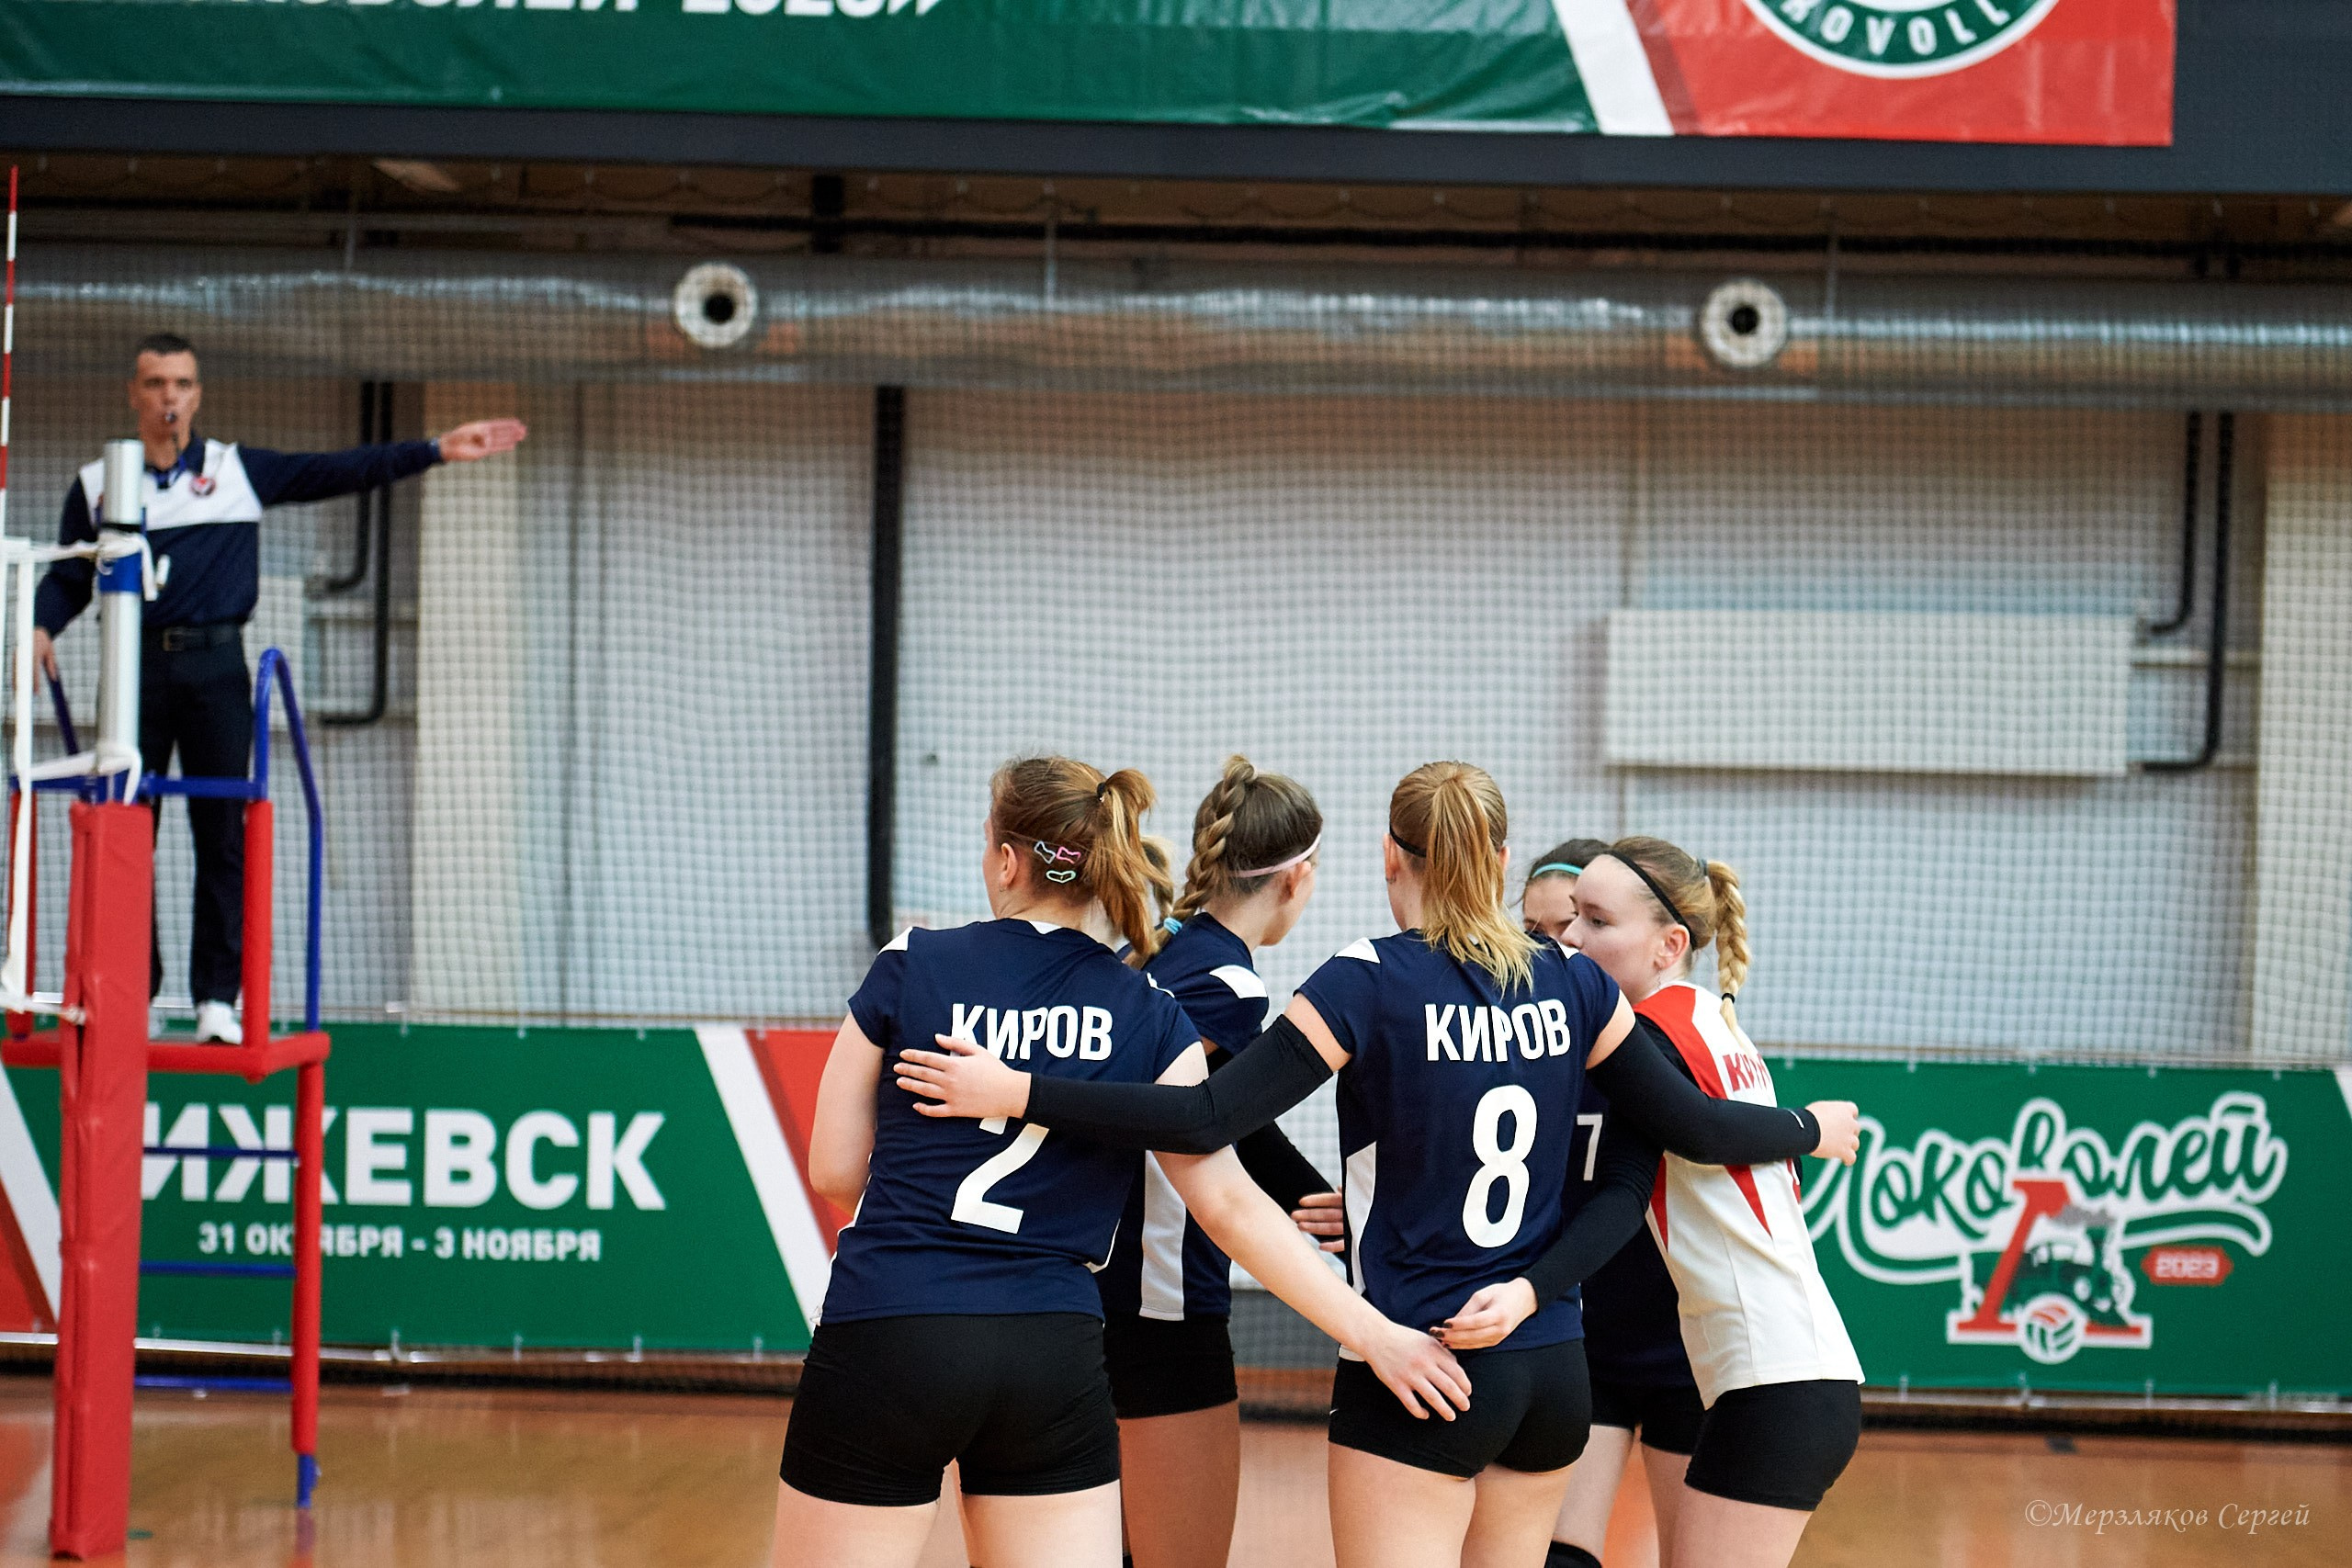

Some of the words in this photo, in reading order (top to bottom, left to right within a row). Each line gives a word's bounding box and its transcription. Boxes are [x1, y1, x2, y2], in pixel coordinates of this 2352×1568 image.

[950, 1003, 1114, 1061] КИРОВ
[1425, 998, 1571, 1063] КИРОВ
[141, 1101, 666, 1211] ИЖЕВСК
[950, 1117, 1049, 1235] 2
[1462, 1084, 1538, 1249] 8
[1577, 1113, 1603, 1181] 7
[198, 1221, 235, 1255] 31
[244, 1222, 402, 1258] ОКЯБРЯ
[434, 1225, 455, 1259] 3
[462, 1227, 600, 1261] НОЯБРЯ
[2154, 1251, 2221, 1280] 2023
